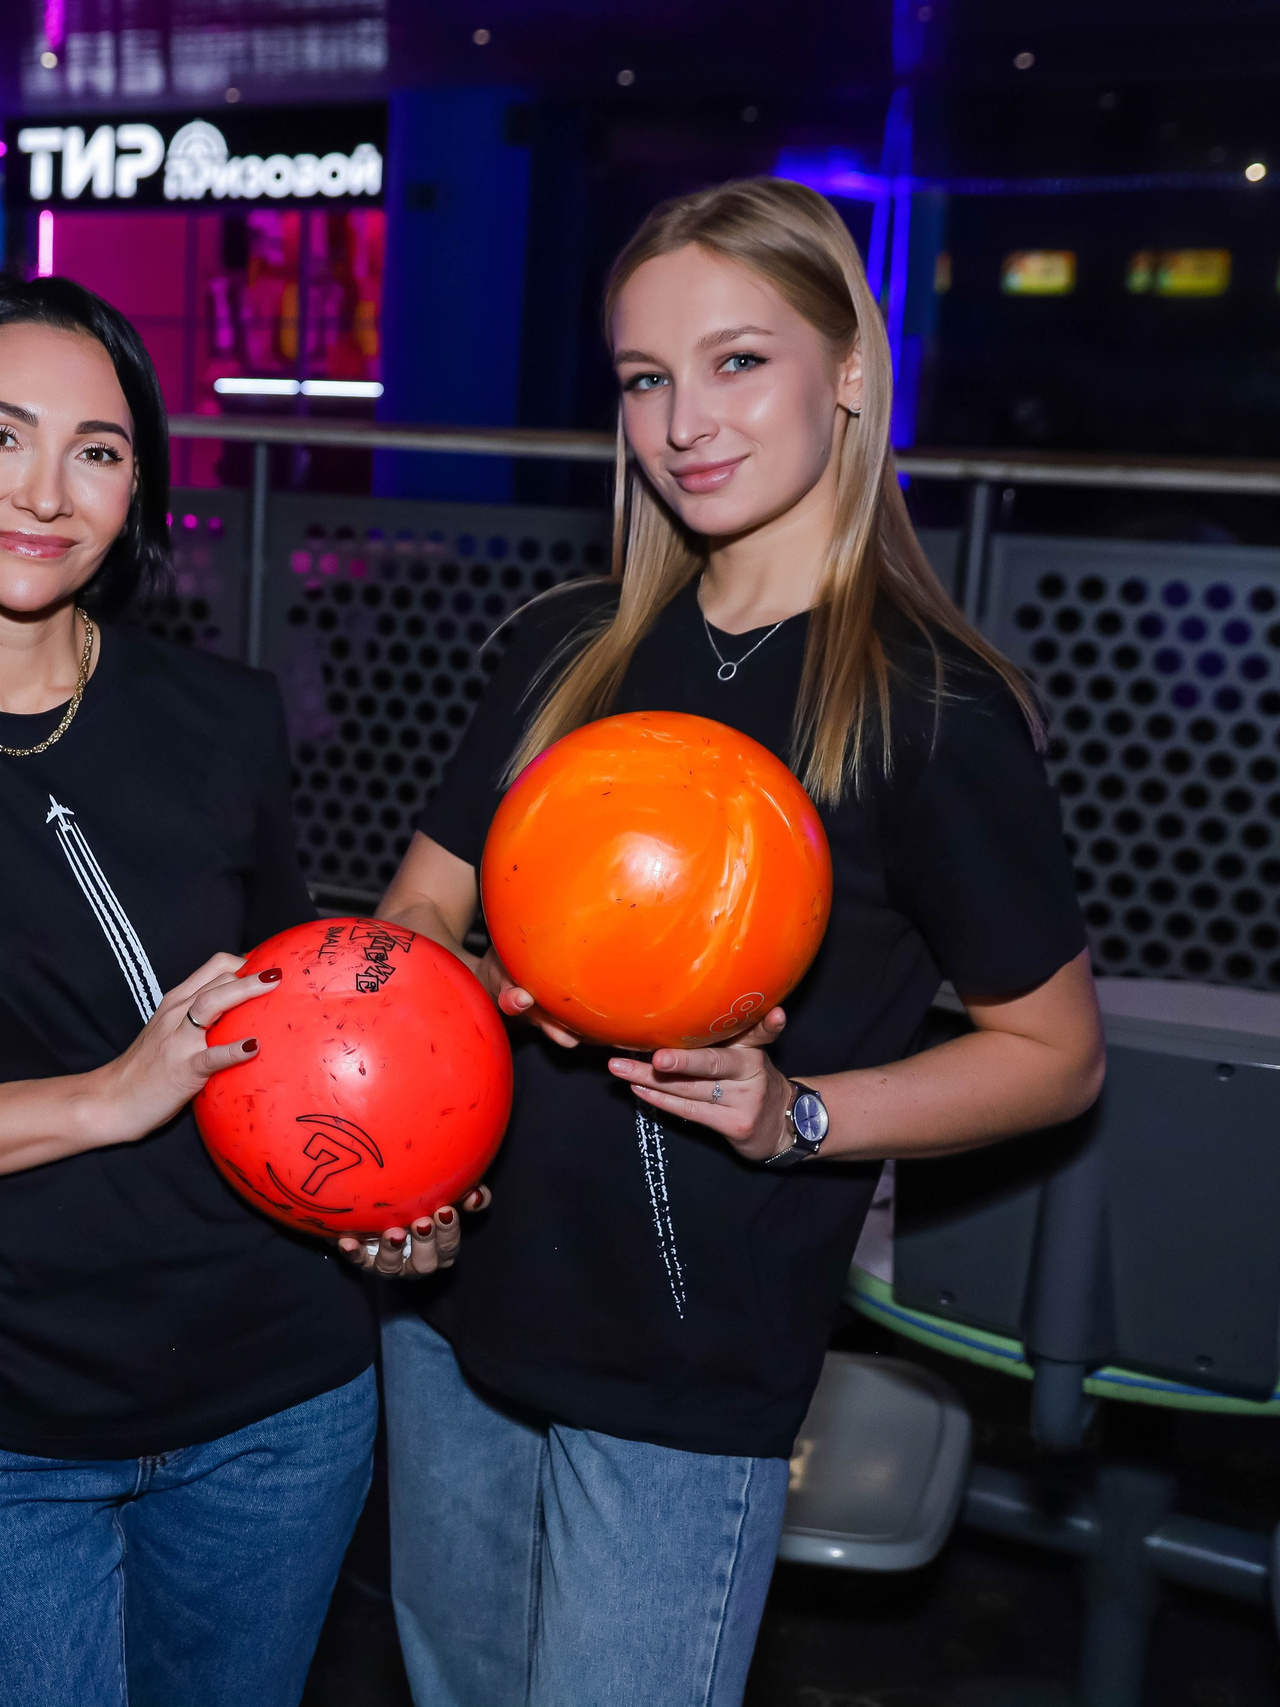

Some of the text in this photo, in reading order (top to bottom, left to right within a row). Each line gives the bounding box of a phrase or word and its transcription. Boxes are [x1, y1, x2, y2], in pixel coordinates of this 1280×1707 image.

[18, 124, 164, 200] ТИР
[318, 927, 345, 958] SMALL
[709, 992, 765, 1035] 8
[303, 1132, 362, 1195] 7
